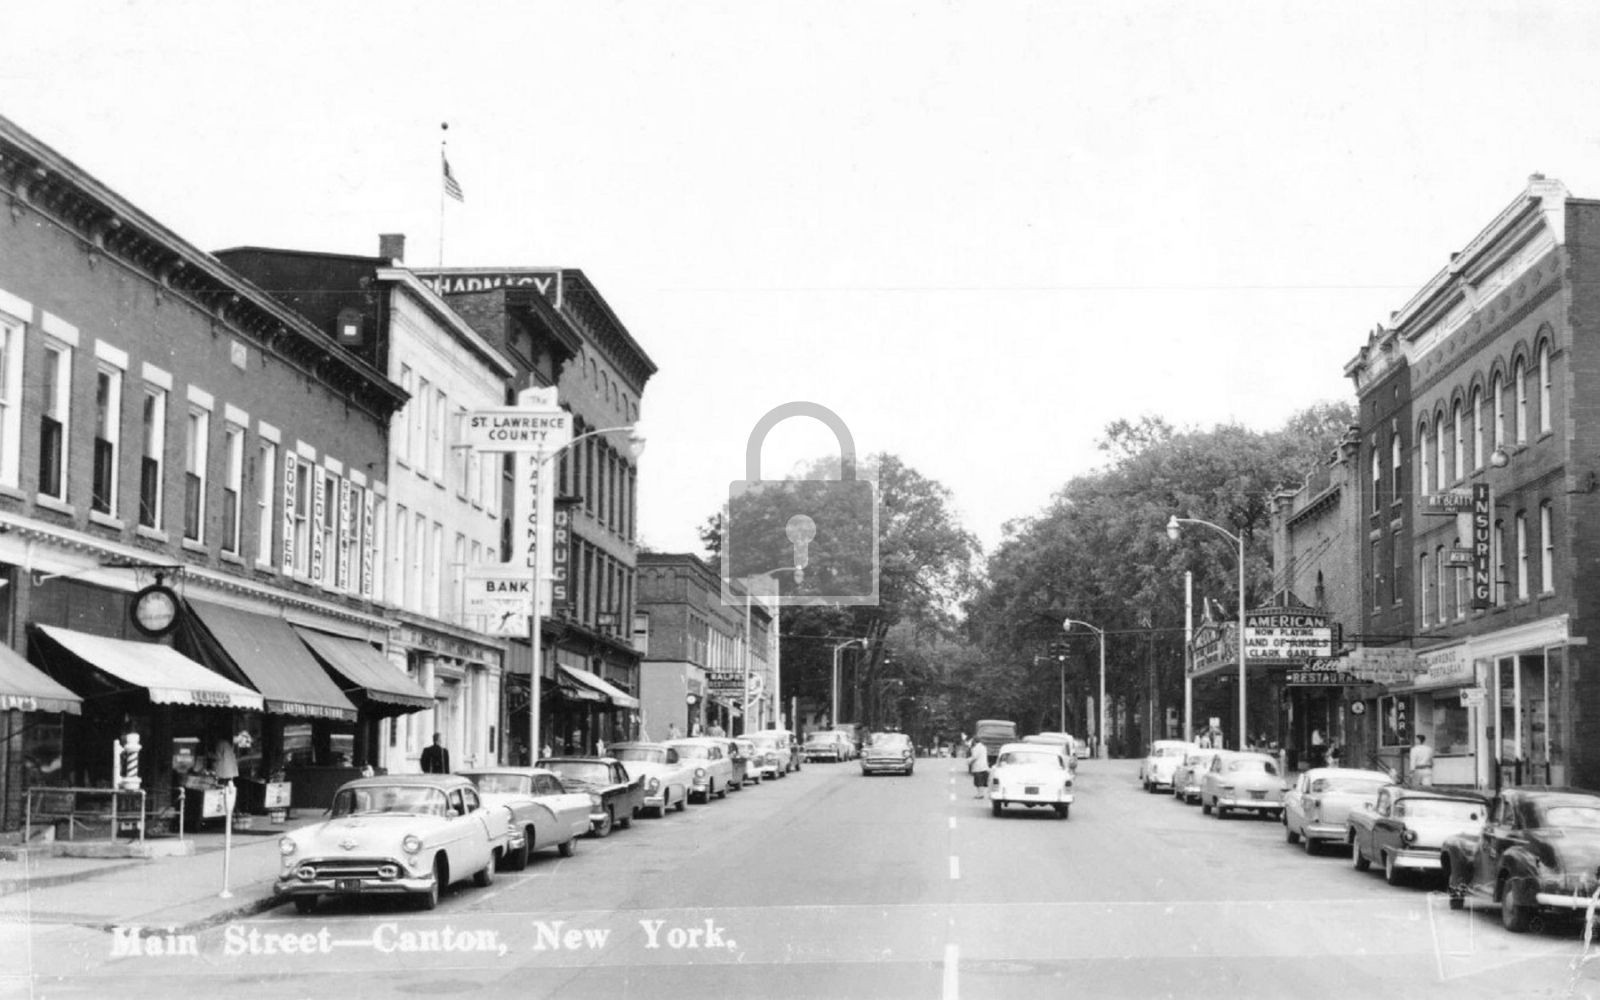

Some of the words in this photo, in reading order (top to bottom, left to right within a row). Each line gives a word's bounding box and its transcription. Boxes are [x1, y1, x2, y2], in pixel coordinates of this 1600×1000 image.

[493, 417, 565, 429] LAWRENCE
[489, 429, 548, 441] COUNTY
[526, 455, 540, 569] NATIONAL
[313, 469, 324, 581] LEONARD
[1476, 487, 1489, 600] INSURING
[553, 510, 568, 601] DRUGS
[486, 580, 530, 593] BANK
[1248, 615, 1325, 627] AMERICAN
[1280, 628, 1314, 636] PLAYING
[1273, 638, 1286, 647] OF
[1289, 638, 1329, 647] ANGELS
[1249, 649, 1281, 657] CLARK
[1286, 649, 1317, 657] GABLE
[1397, 701, 1405, 730] BAR
